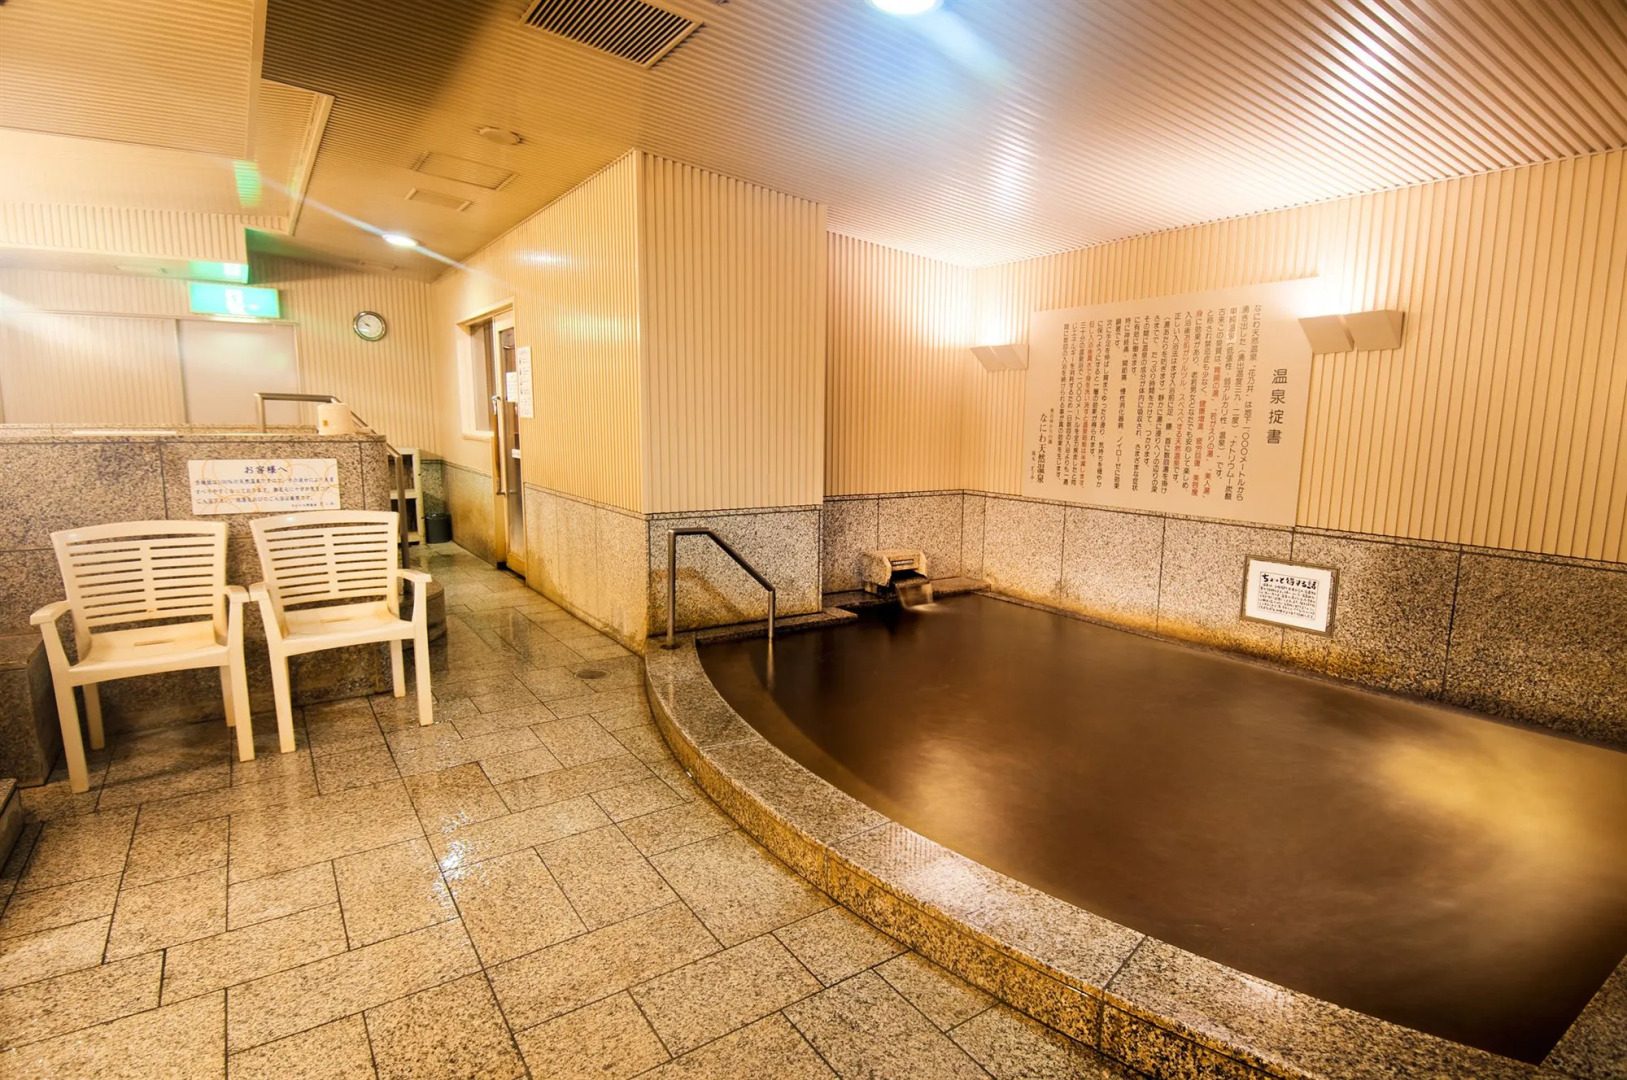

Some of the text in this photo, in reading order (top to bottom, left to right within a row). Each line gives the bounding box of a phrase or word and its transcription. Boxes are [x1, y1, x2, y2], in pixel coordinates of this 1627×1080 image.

[1266, 368, 1288, 445] 温泉掟書
[244, 465, 288, 474] お客様へ
[1036, 412, 1048, 484] なにわ天然温泉
